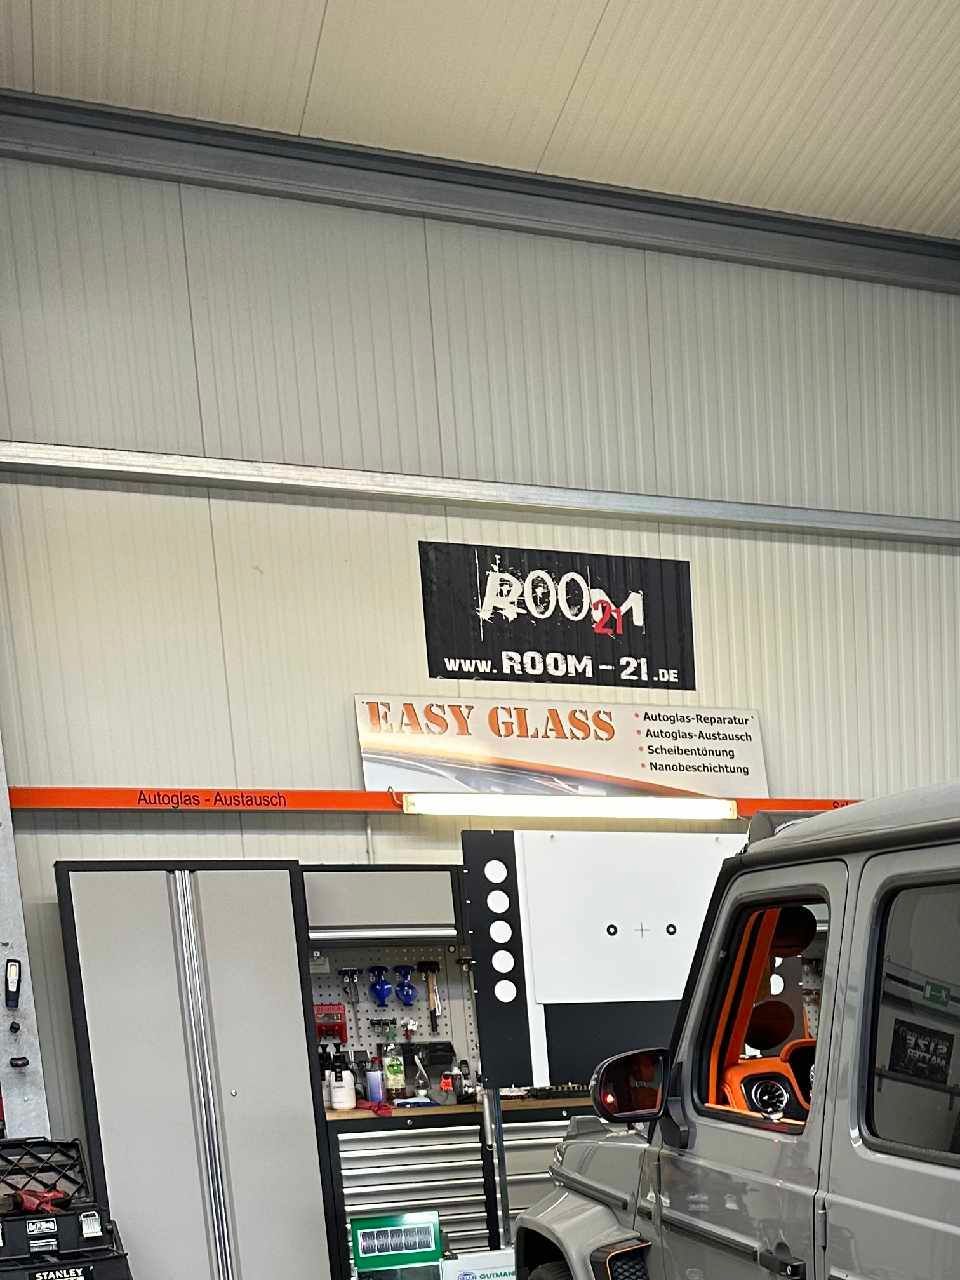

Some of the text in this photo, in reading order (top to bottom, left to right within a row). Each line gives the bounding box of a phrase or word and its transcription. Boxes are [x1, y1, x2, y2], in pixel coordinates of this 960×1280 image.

[477, 562, 645, 632] ROOM
[591, 599, 624, 636] 21
[366, 701, 616, 741] EASY GLASS
[643, 711, 750, 726] Autoglas-Reparatur
[645, 728, 752, 742] Autoglas-Austausch
[647, 745, 735, 759] Scheibentönung
[649, 762, 749, 776] Nanobeschichtung
[137, 790, 200, 809] Autoglas
[213, 792, 287, 807] Austausch
